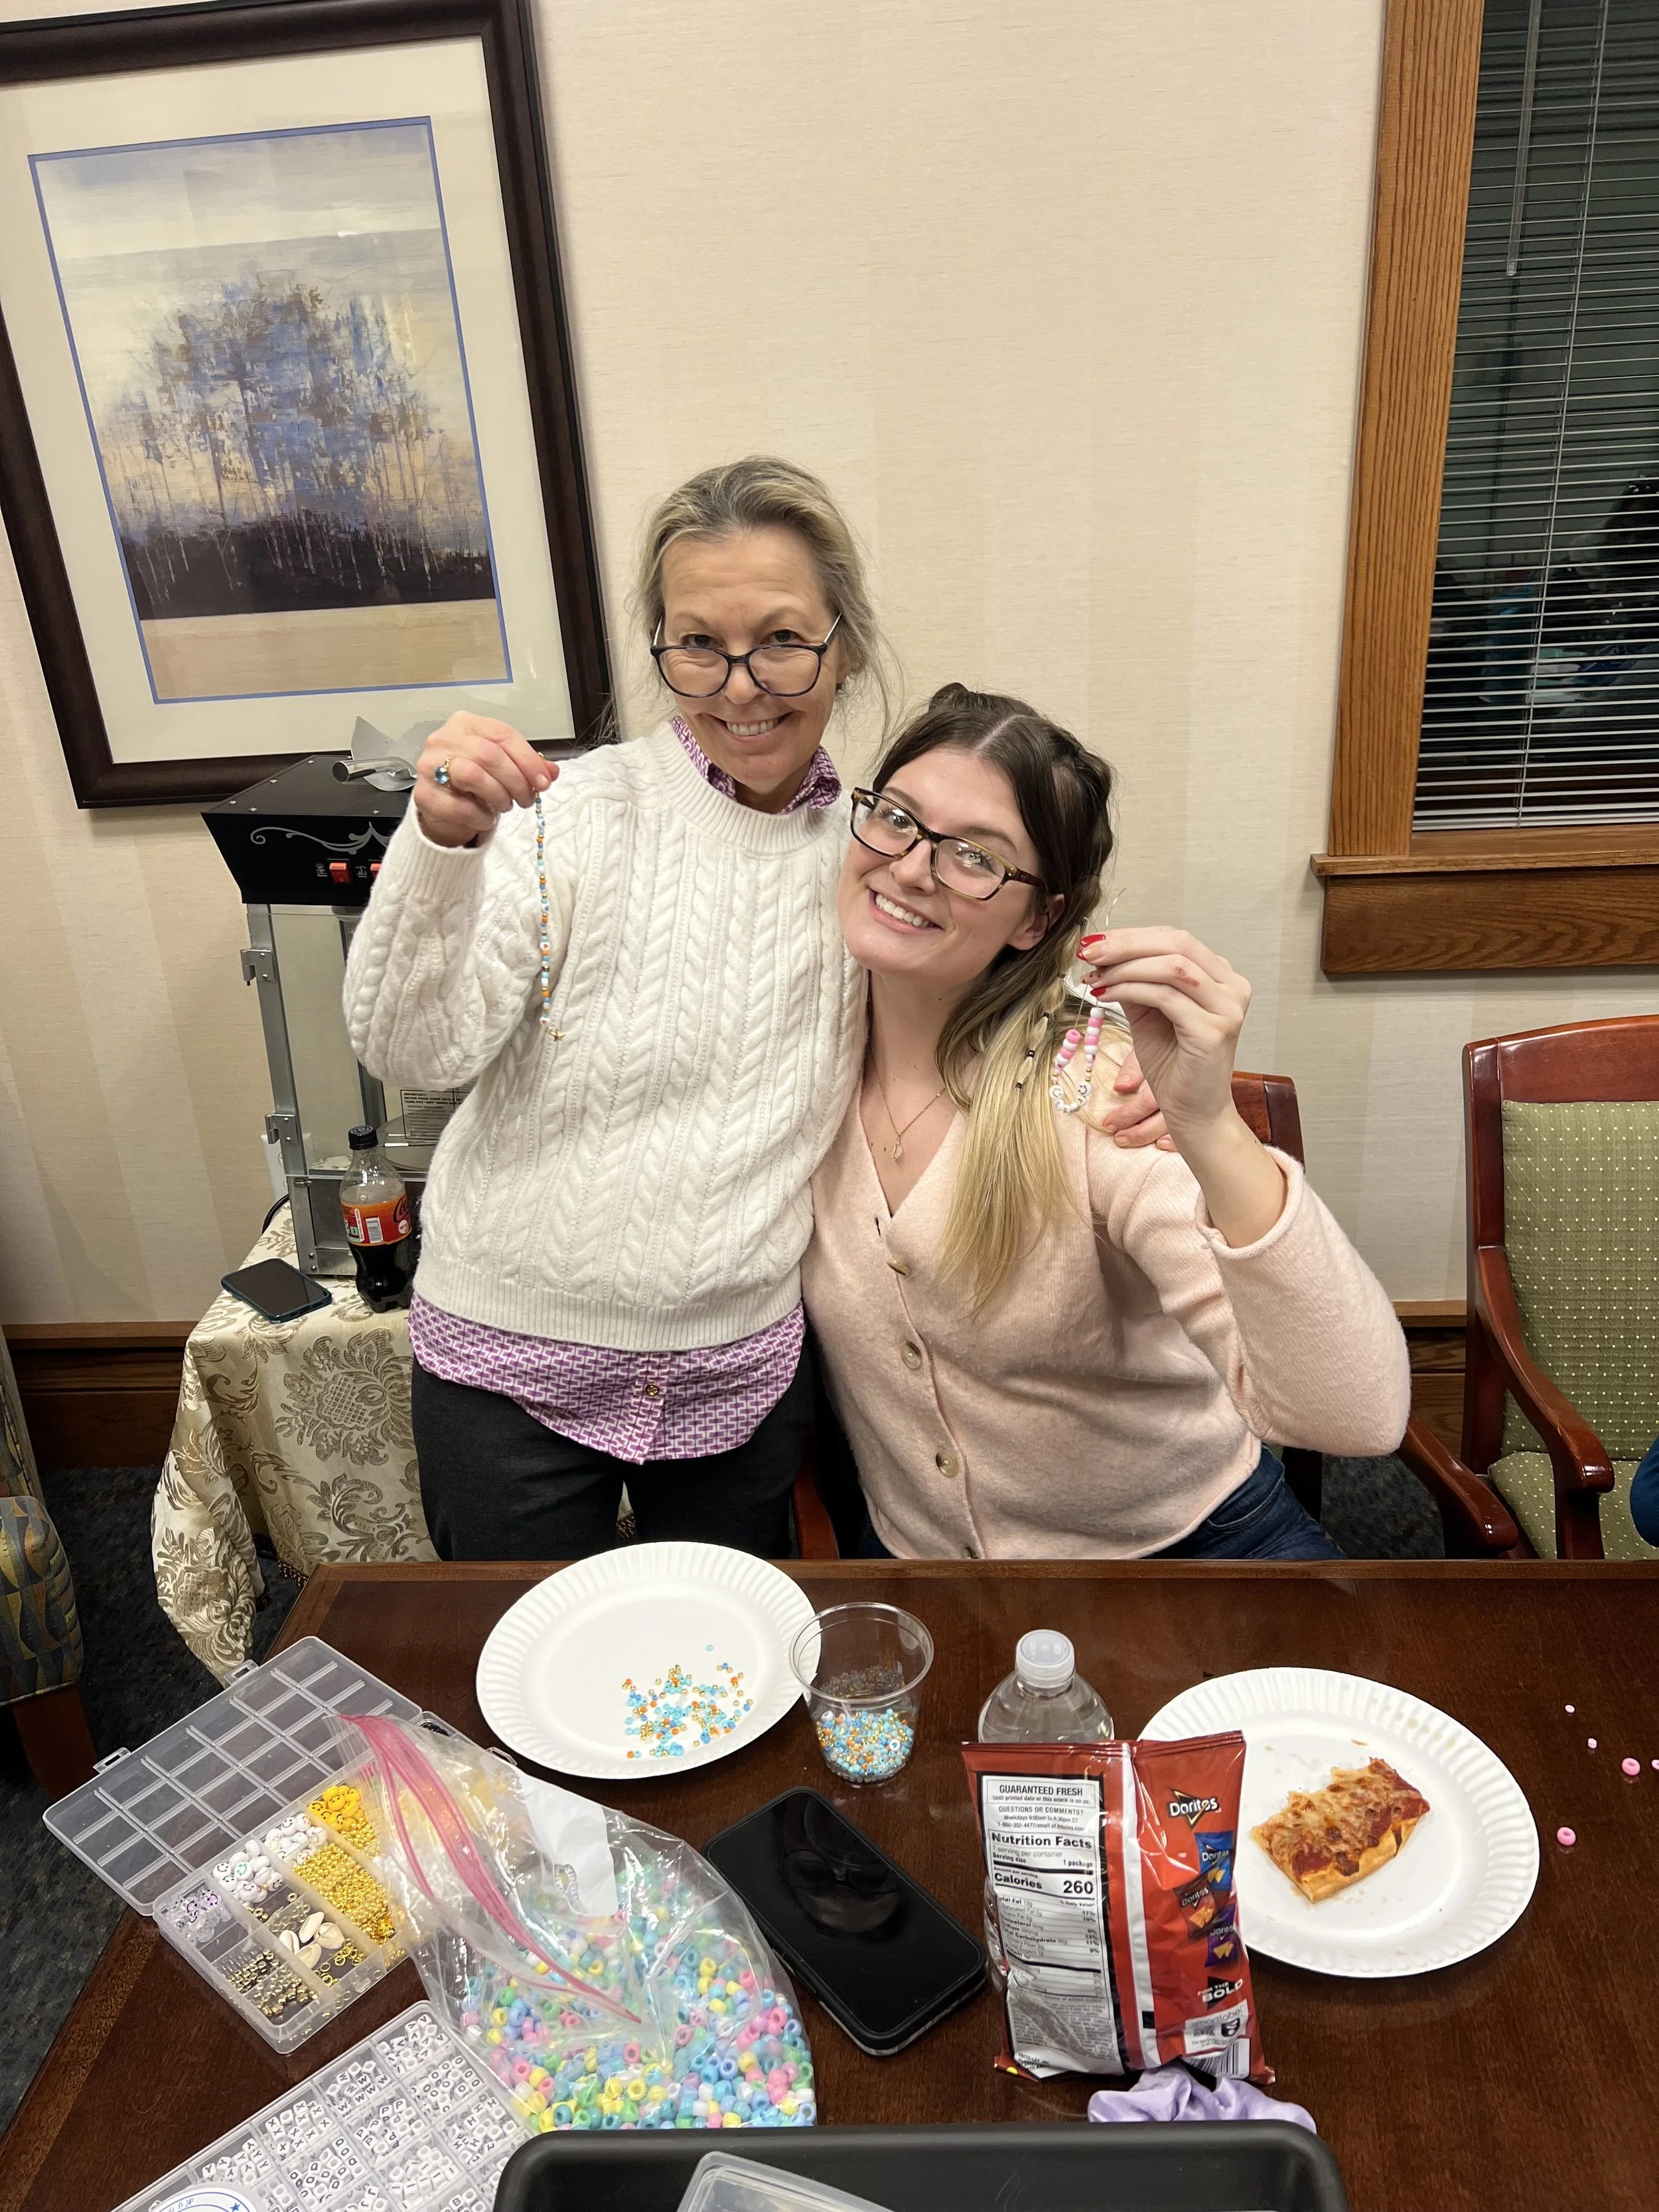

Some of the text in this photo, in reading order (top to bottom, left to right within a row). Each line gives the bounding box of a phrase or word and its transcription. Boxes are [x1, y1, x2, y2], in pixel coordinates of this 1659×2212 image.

[1000, 1785, 1083, 1796] GUARANTEED FRESH
[1045, 1807, 1084, 1816] COMMENTS?
[1170, 1798, 1218, 1816] Doritos
[992, 1832, 1092, 1849] Nutrition Facts
[993, 1852, 1014, 1862] Serving
[998, 1847, 1019, 1857] serving
[1202, 1850, 1229, 1861] Doritos
[994, 1873, 1094, 1894] Calories 260
[1182, 1887, 1209, 1906] Doritos
[1015, 1932, 1056, 1943] Carbohydrate
[1202, 1978, 1244, 2003] BOLD
[1214, 1982, 1229, 1990] THE
